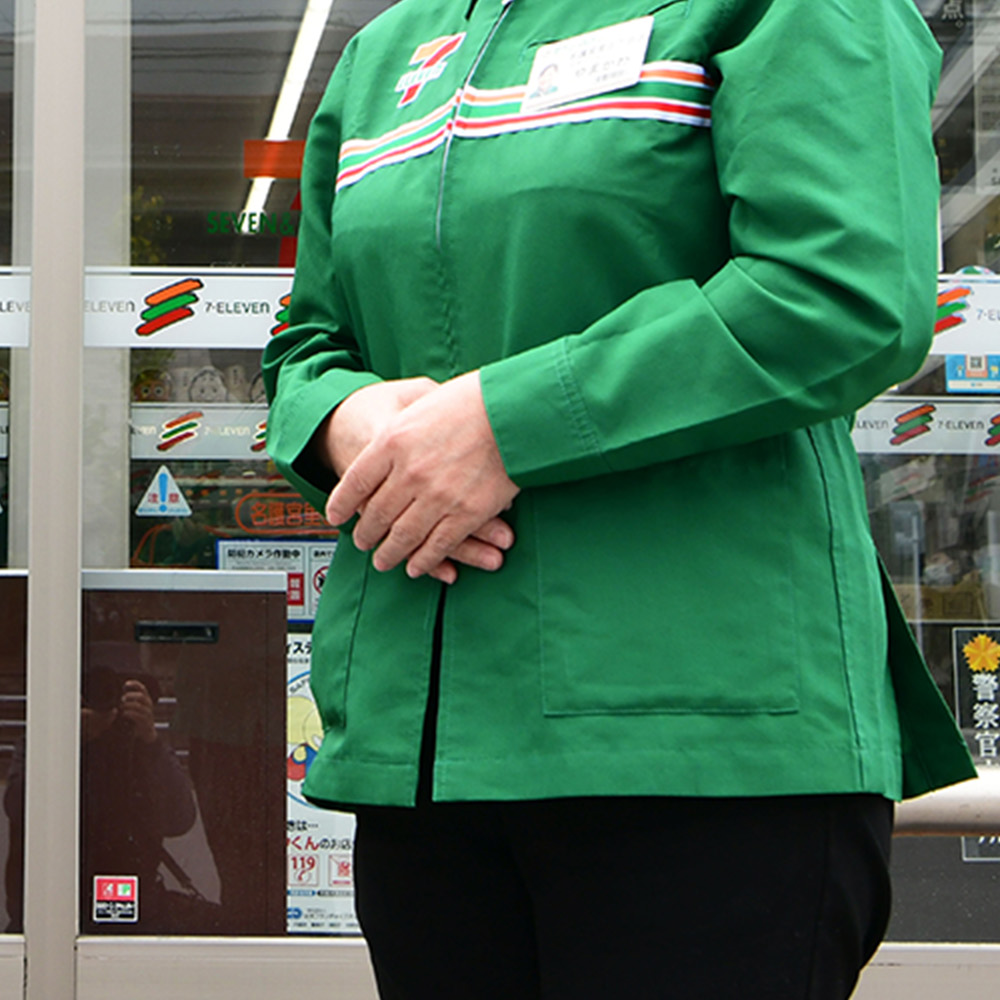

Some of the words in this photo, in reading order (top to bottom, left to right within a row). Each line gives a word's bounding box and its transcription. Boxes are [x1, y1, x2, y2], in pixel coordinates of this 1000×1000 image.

[84, 301, 135, 312] ELEVEn
[857, 420, 889, 430] LEVEn
[971, 673, 999, 766] 警察官
[292, 856, 316, 870] 119
